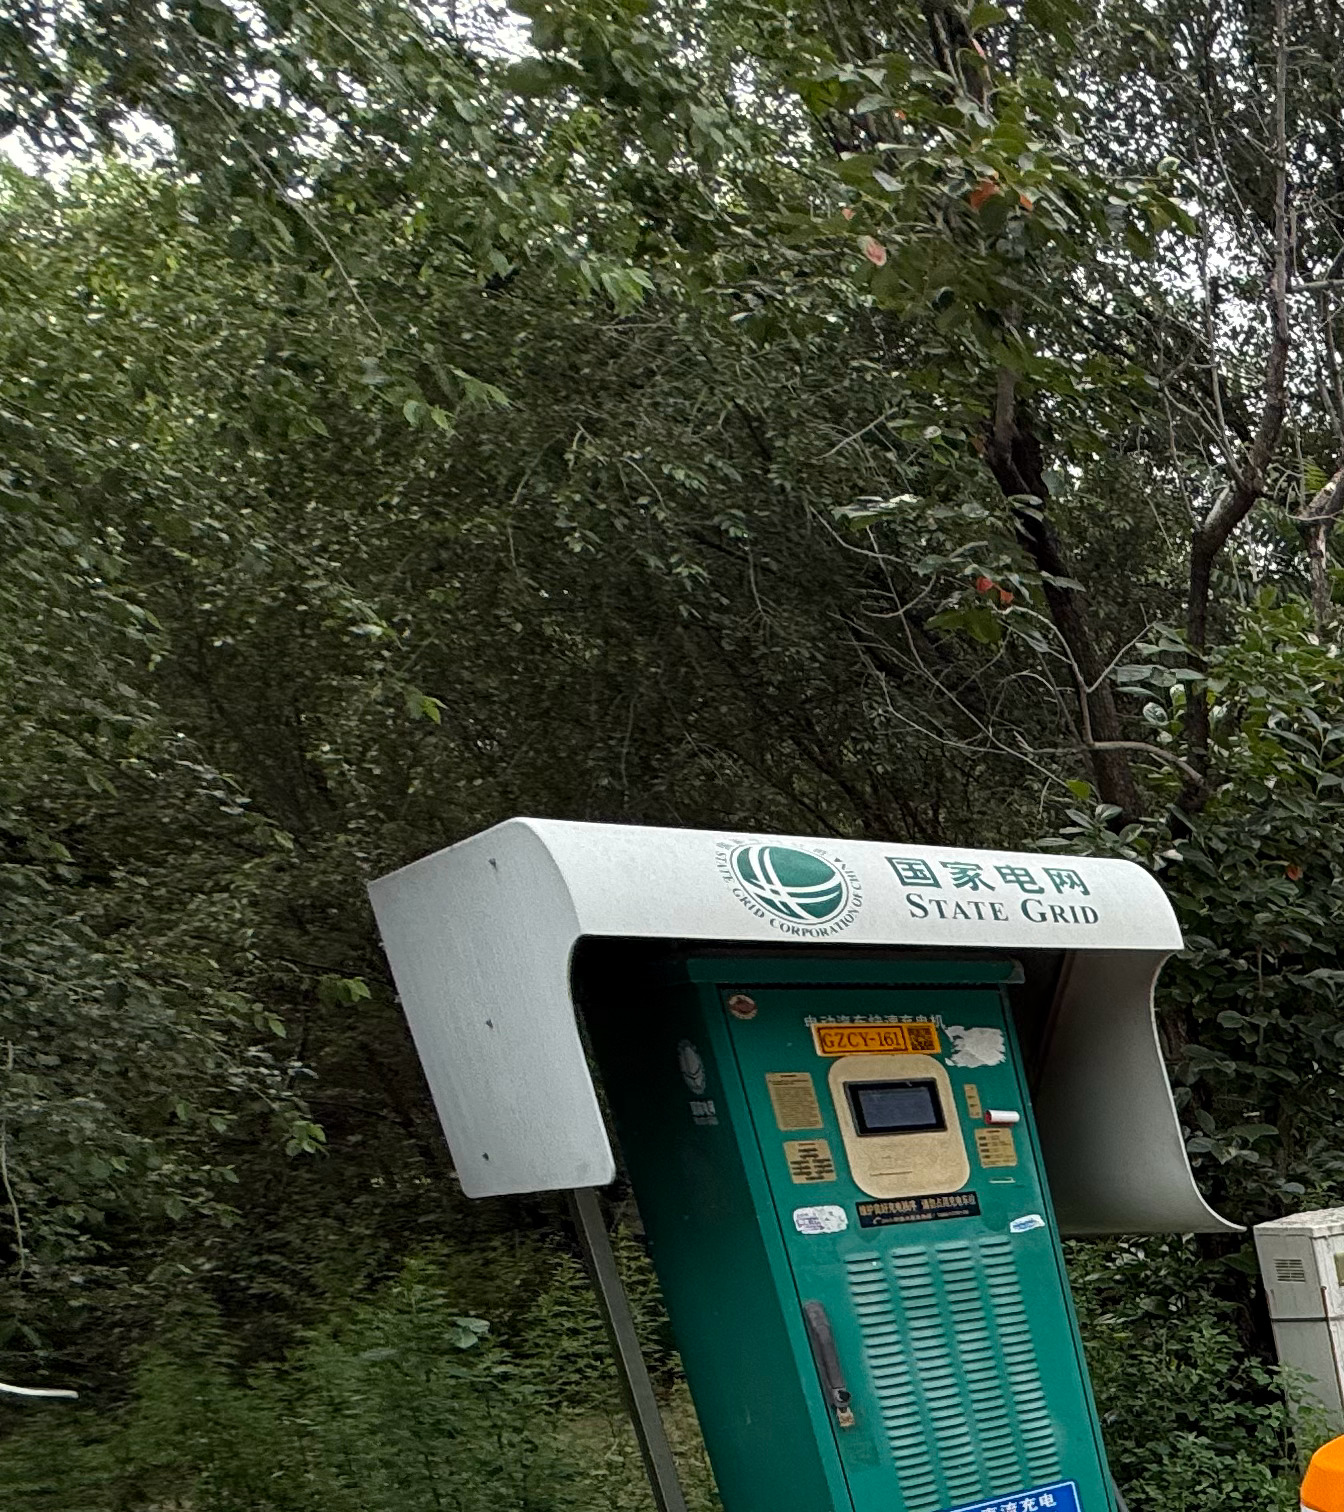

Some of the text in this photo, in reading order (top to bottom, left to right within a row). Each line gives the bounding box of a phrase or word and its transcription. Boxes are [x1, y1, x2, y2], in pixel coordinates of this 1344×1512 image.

[885, 856, 1091, 896] 国家电网
[769, 907, 860, 938] CORPORATION
[905, 893, 1099, 924] STATE GRID
[822, 1031, 902, 1048] GZCY-161
